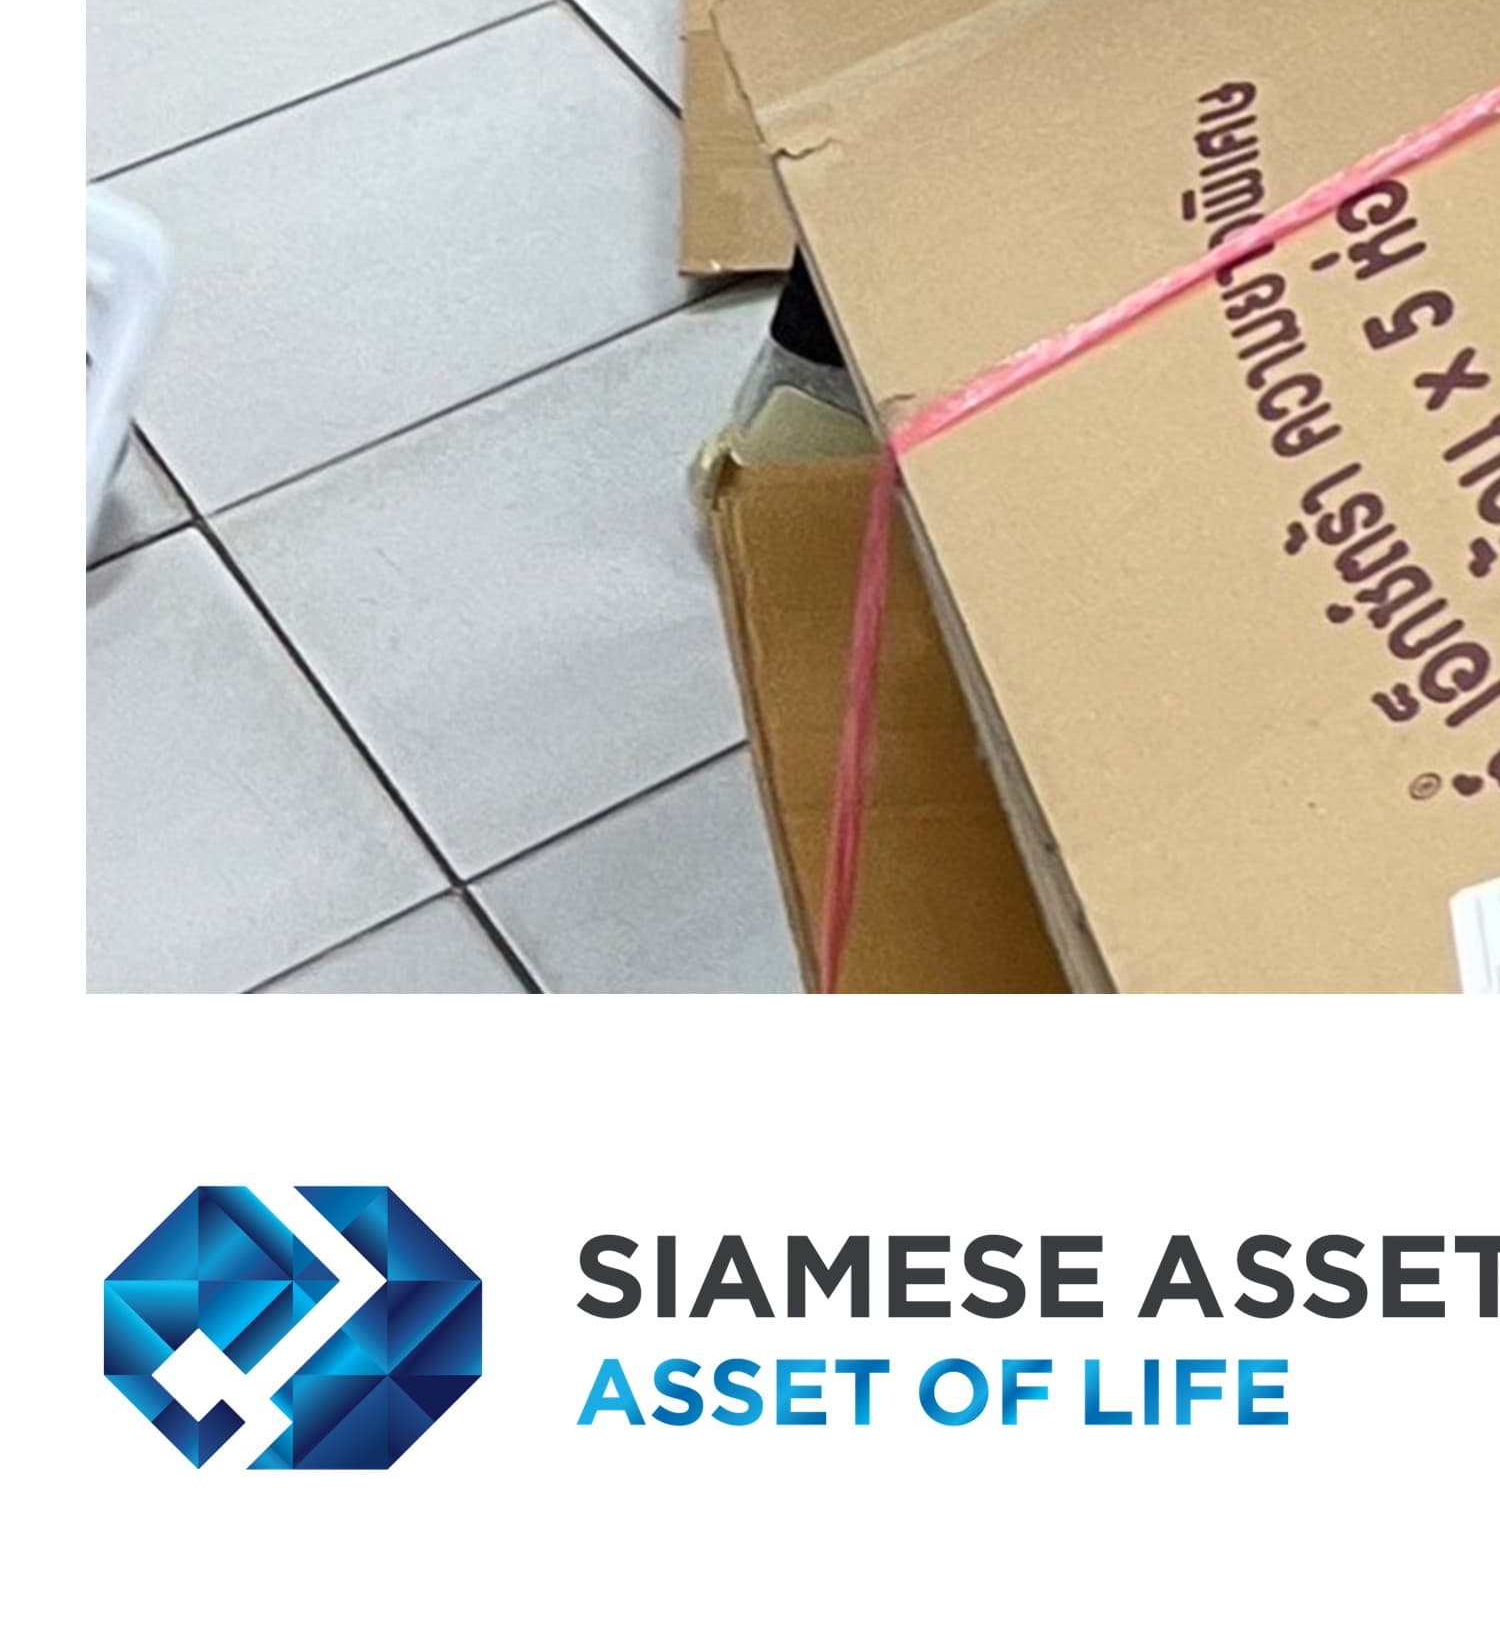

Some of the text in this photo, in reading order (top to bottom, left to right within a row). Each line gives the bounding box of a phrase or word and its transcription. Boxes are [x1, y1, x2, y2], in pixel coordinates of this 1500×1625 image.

[1309, 177, 1428, 281] ห่อ
[1363, 289, 1455, 351] 5
[1413, 346, 1491, 411] x
